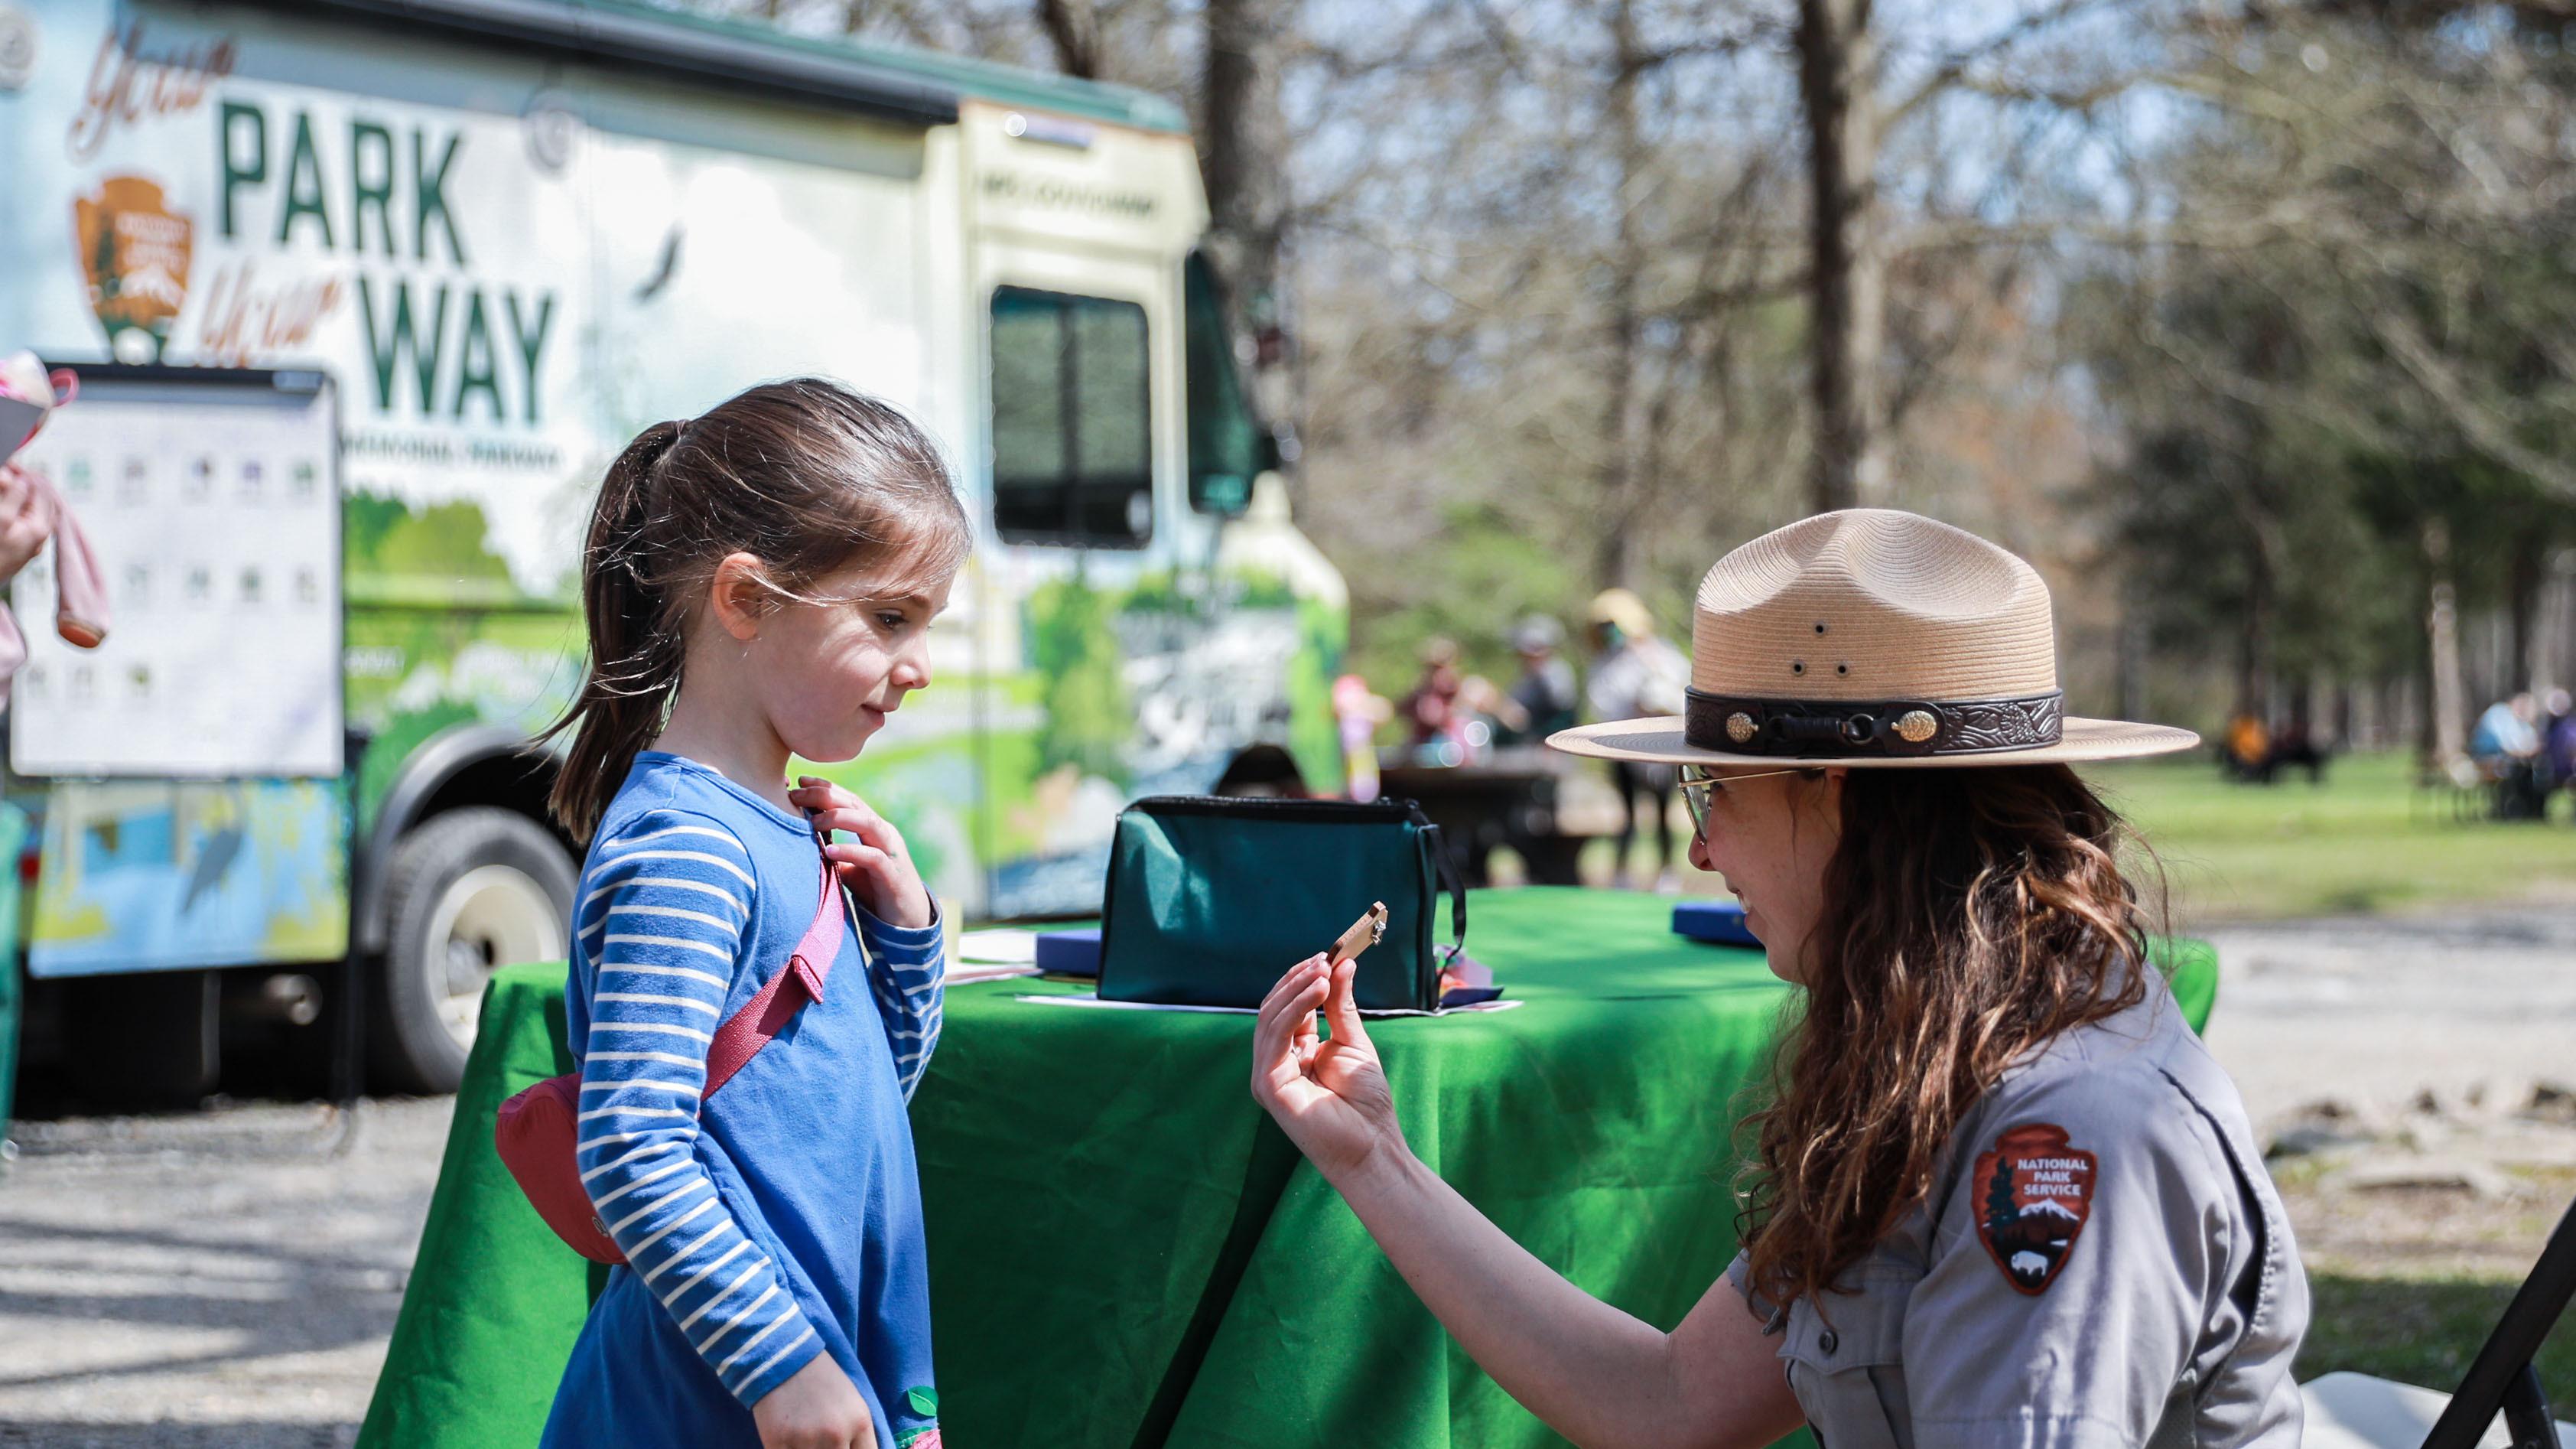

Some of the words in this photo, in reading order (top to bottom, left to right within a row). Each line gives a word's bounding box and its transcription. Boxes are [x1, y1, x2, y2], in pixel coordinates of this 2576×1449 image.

[222, 100, 465, 265] PARK
[359, 275, 552, 425] WAY
[2018, 1159, 2088, 1171] NATIONAL
[2034, 1171, 2070, 1182] PARK
[2023, 1184, 2081, 1196] SERVICE
